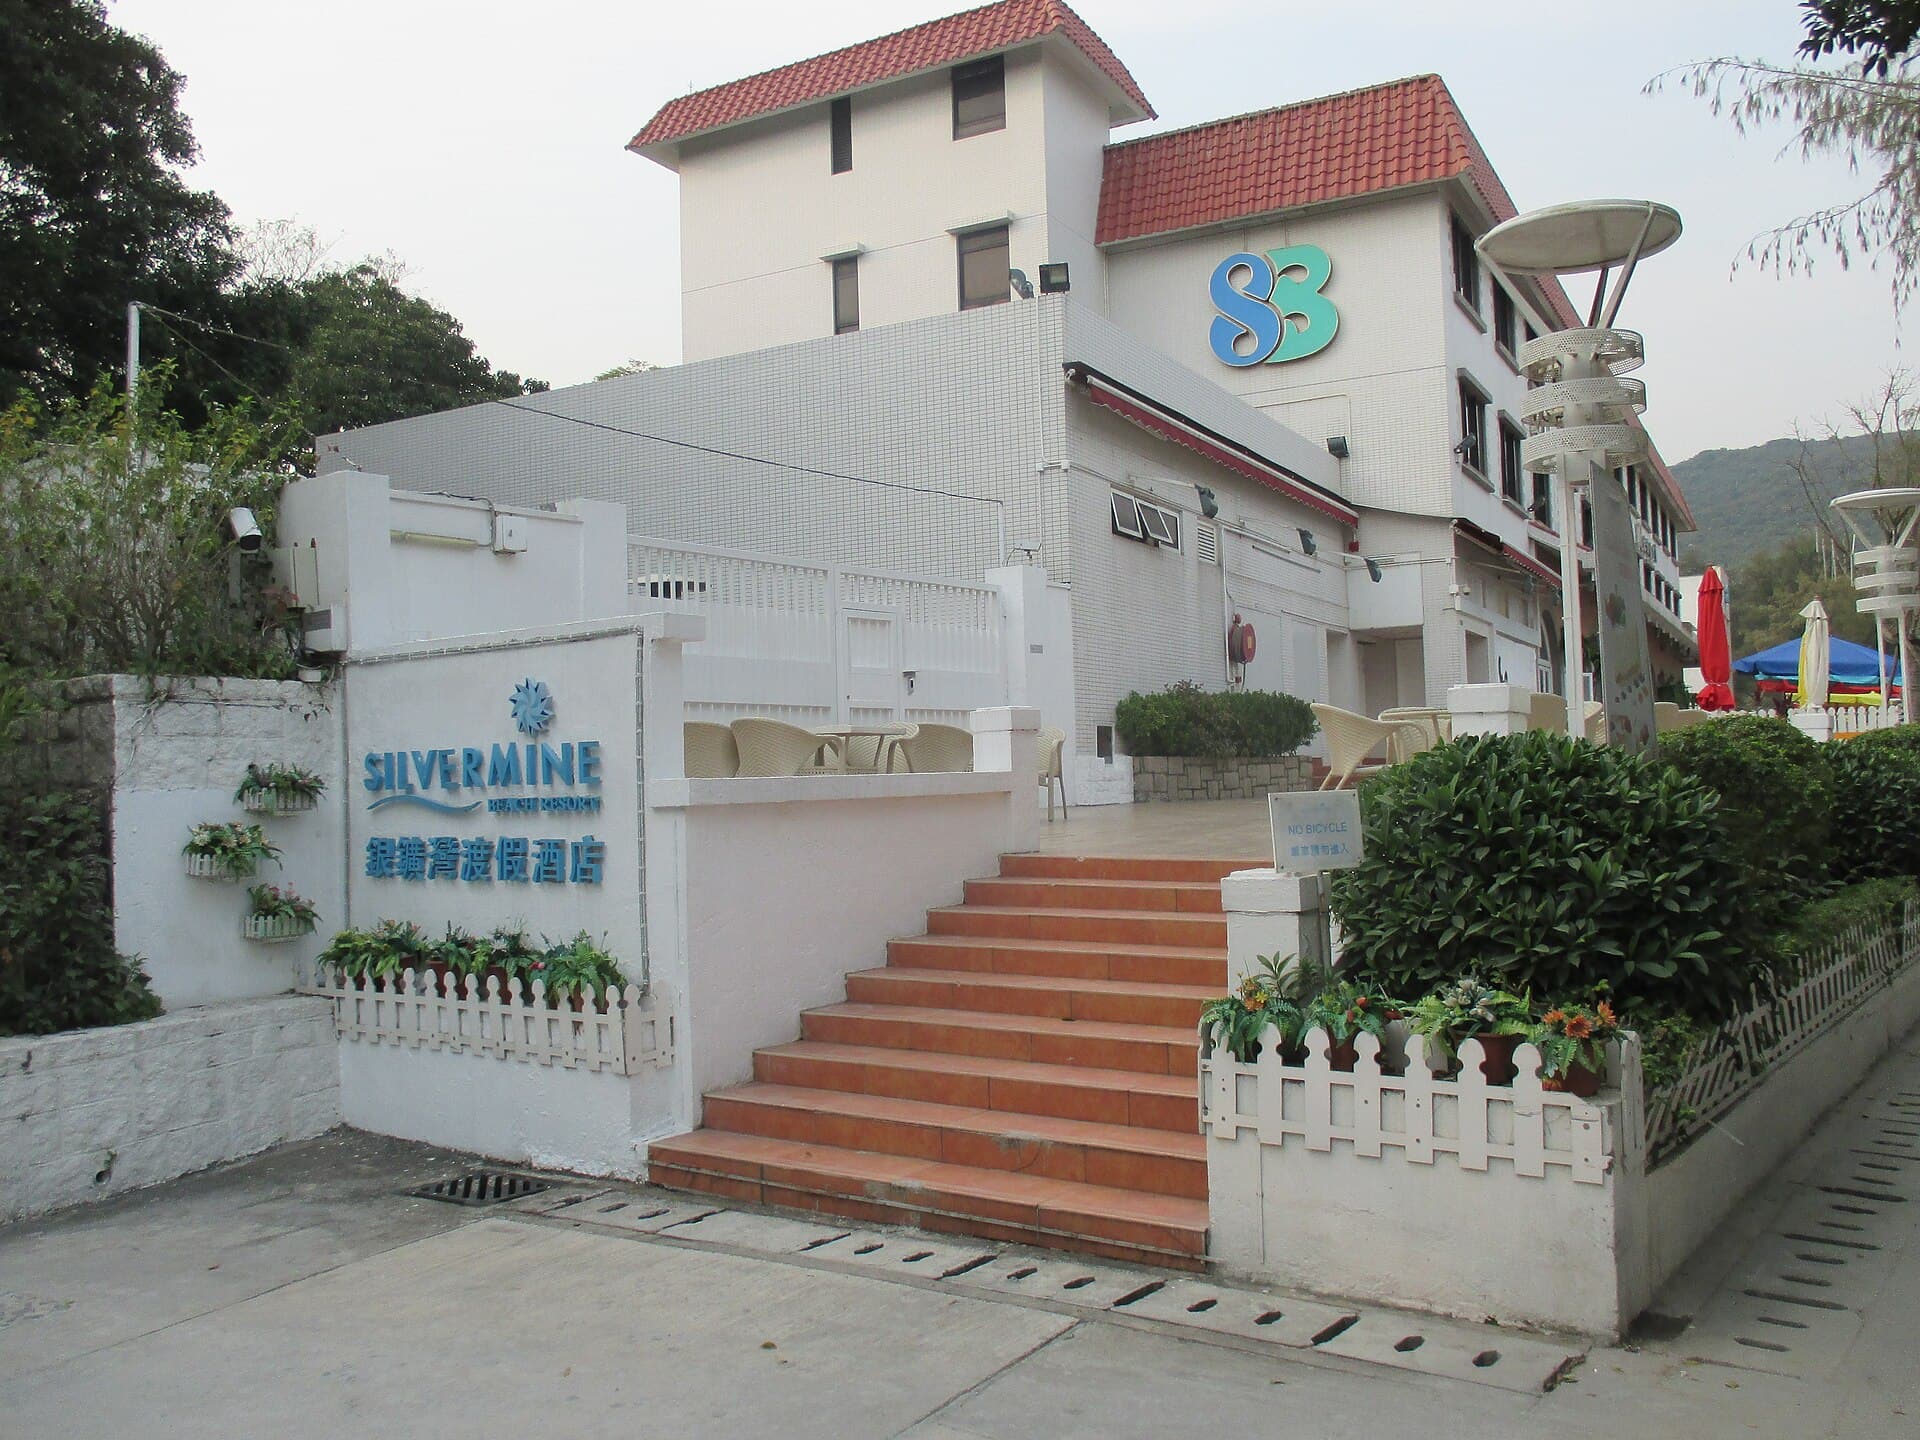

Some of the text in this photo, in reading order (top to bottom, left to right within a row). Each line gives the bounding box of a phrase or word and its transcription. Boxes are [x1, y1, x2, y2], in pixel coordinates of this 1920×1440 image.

[363, 741, 602, 792] SILVERMINE
[488, 795, 601, 813] BEACH RESORT
[1288, 823, 1347, 835] NO BICYCLE
